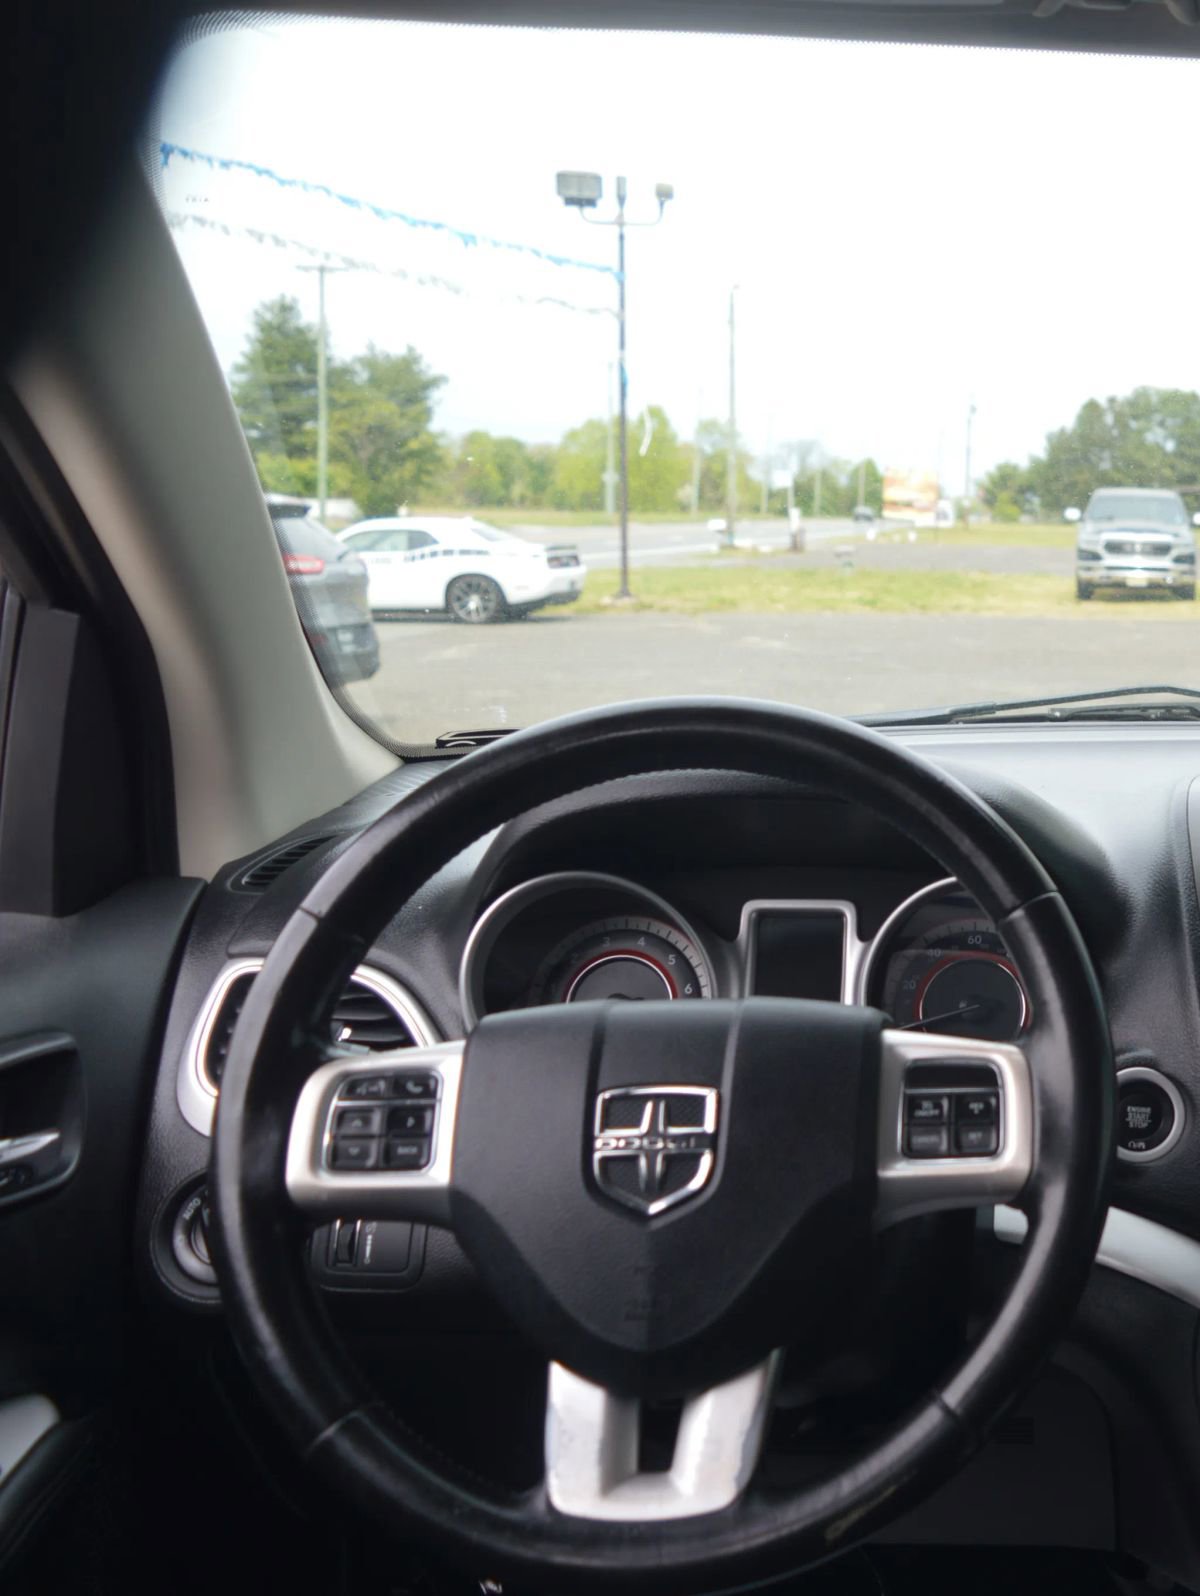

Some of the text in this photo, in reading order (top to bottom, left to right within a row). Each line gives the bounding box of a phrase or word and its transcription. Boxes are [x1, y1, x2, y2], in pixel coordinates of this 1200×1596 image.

[602, 936, 611, 947] 3
[636, 936, 646, 947] 4
[967, 935, 983, 945] 60
[668, 954, 677, 965] 5
[684, 983, 693, 995] 6
